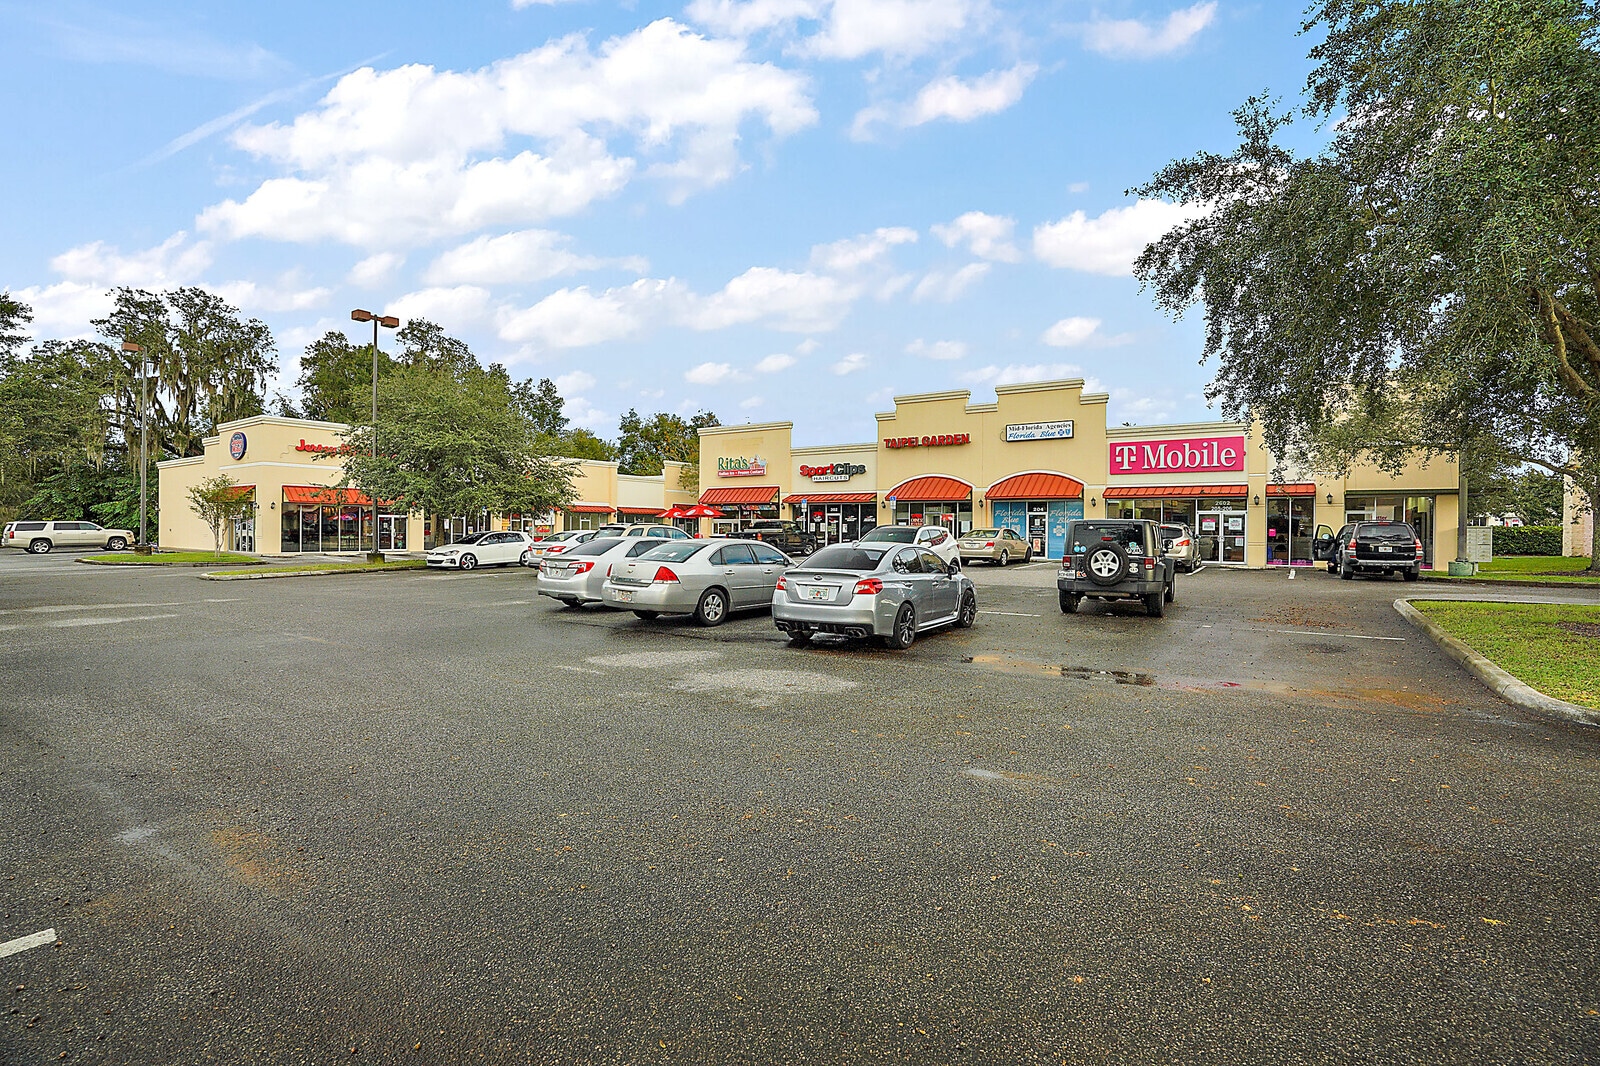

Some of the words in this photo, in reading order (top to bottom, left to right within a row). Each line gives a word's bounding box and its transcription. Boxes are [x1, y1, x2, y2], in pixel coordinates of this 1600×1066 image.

[1046, 422, 1072, 430] Agencies
[883, 437, 919, 449] TAIPEI
[921, 433, 970, 447] GARDEN
[1007, 431, 1036, 440] Florida
[1039, 430, 1057, 438] Blue
[717, 456, 749, 471] Rita's
